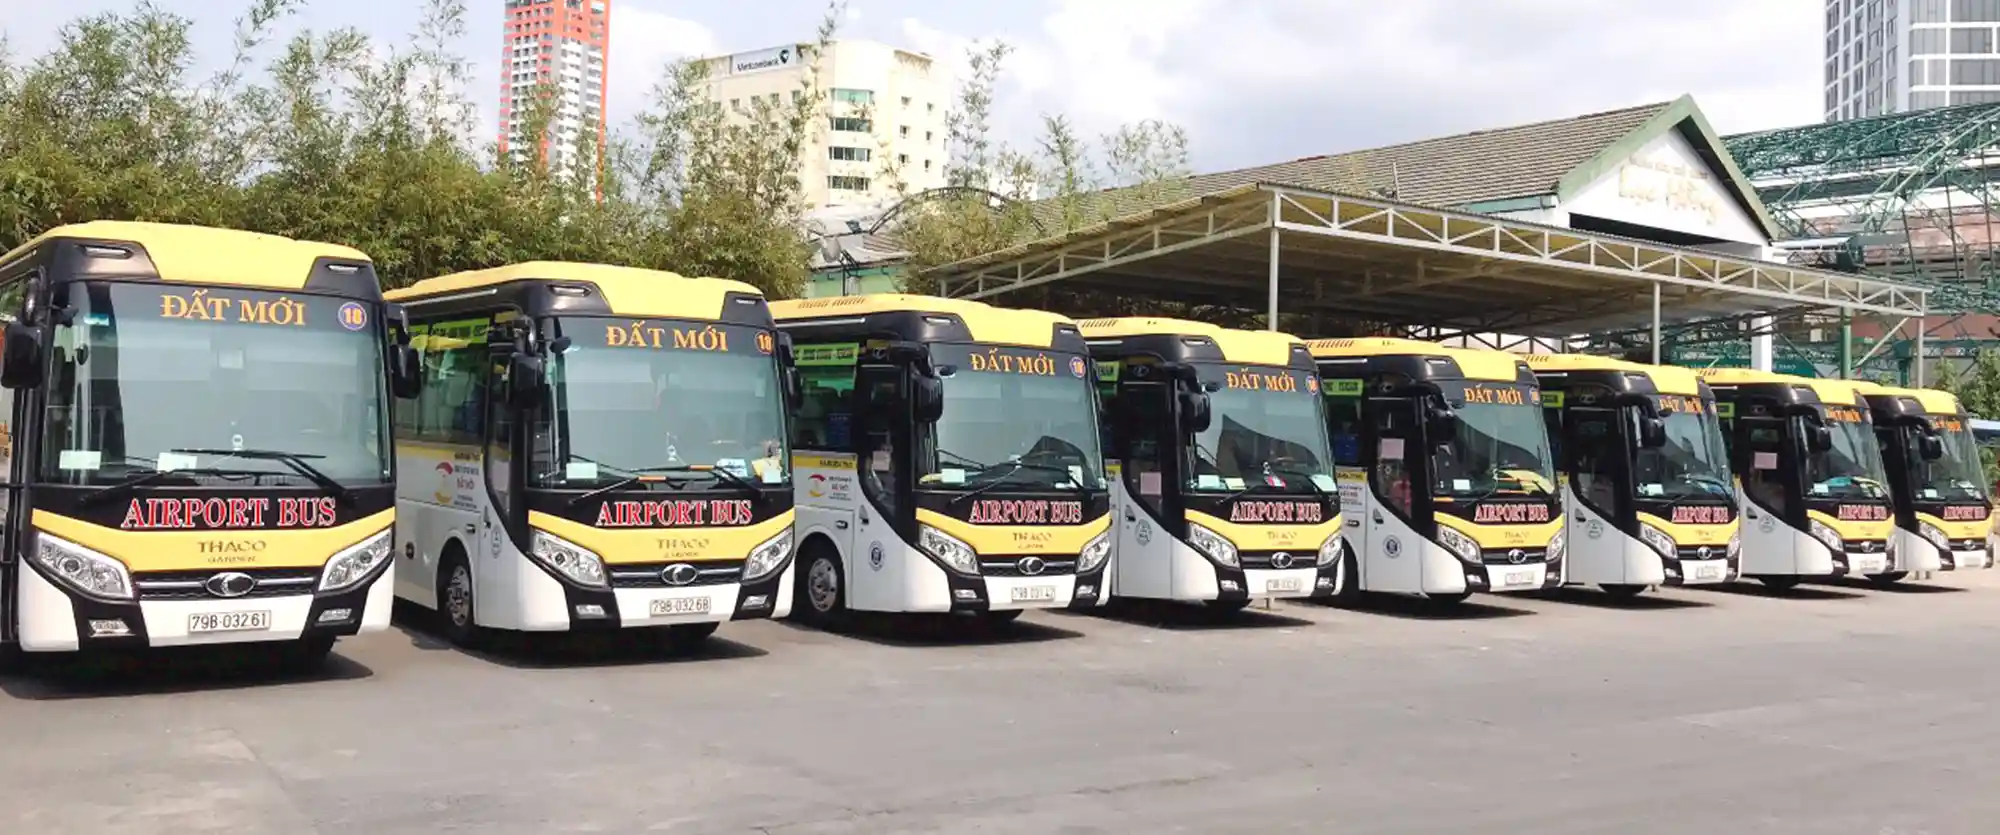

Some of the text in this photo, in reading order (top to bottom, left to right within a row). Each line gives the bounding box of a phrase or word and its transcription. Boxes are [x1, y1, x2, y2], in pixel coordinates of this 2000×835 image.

[160, 288, 306, 326] ĐẤT MỚI
[606, 320, 729, 351] ĐẤT MỚI
[968, 347, 1056, 376] ĐẤT MỚI
[1225, 367, 1261, 390] ĐẤT
[1263, 371, 1297, 392] MỚI
[120, 496, 337, 529] AIRPORT BUS
[595, 499, 753, 527] AIRPORT BUS
[968, 500, 1083, 523] AIRPORT BUS
[1230, 501, 1322, 522] AIRPORT BUS
[1474, 503, 1527, 522] AIRPORT
[197, 539, 267, 554] THACO
